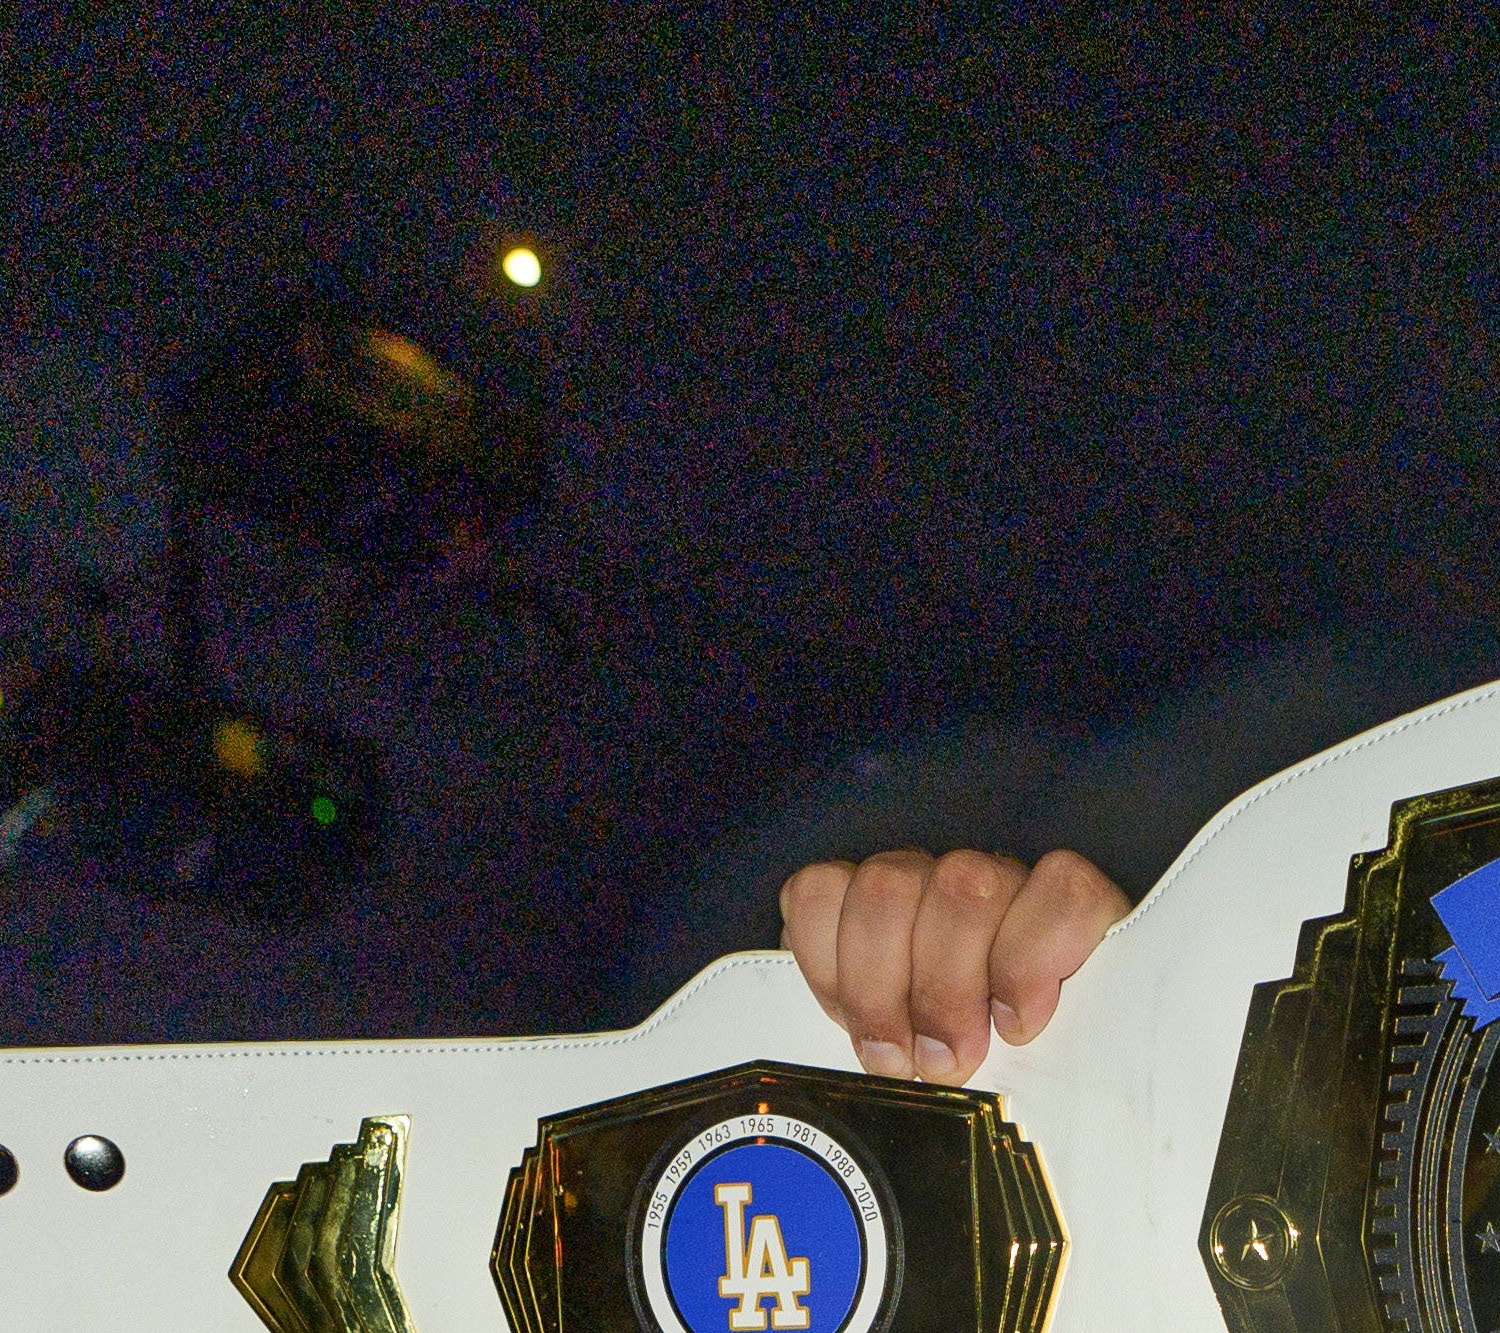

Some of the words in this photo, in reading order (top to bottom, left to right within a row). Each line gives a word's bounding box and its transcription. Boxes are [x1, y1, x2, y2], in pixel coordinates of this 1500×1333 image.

[647, 1191, 669, 1230] 1955
[665, 1149, 693, 1185] 1959
[698, 1124, 732, 1152] 1963
[740, 1117, 775, 1135] 1965
[785, 1121, 818, 1147] 1981
[825, 1144, 856, 1179] 1988
[853, 1181, 879, 1222] 2020
[714, 1182, 810, 1332] LA
